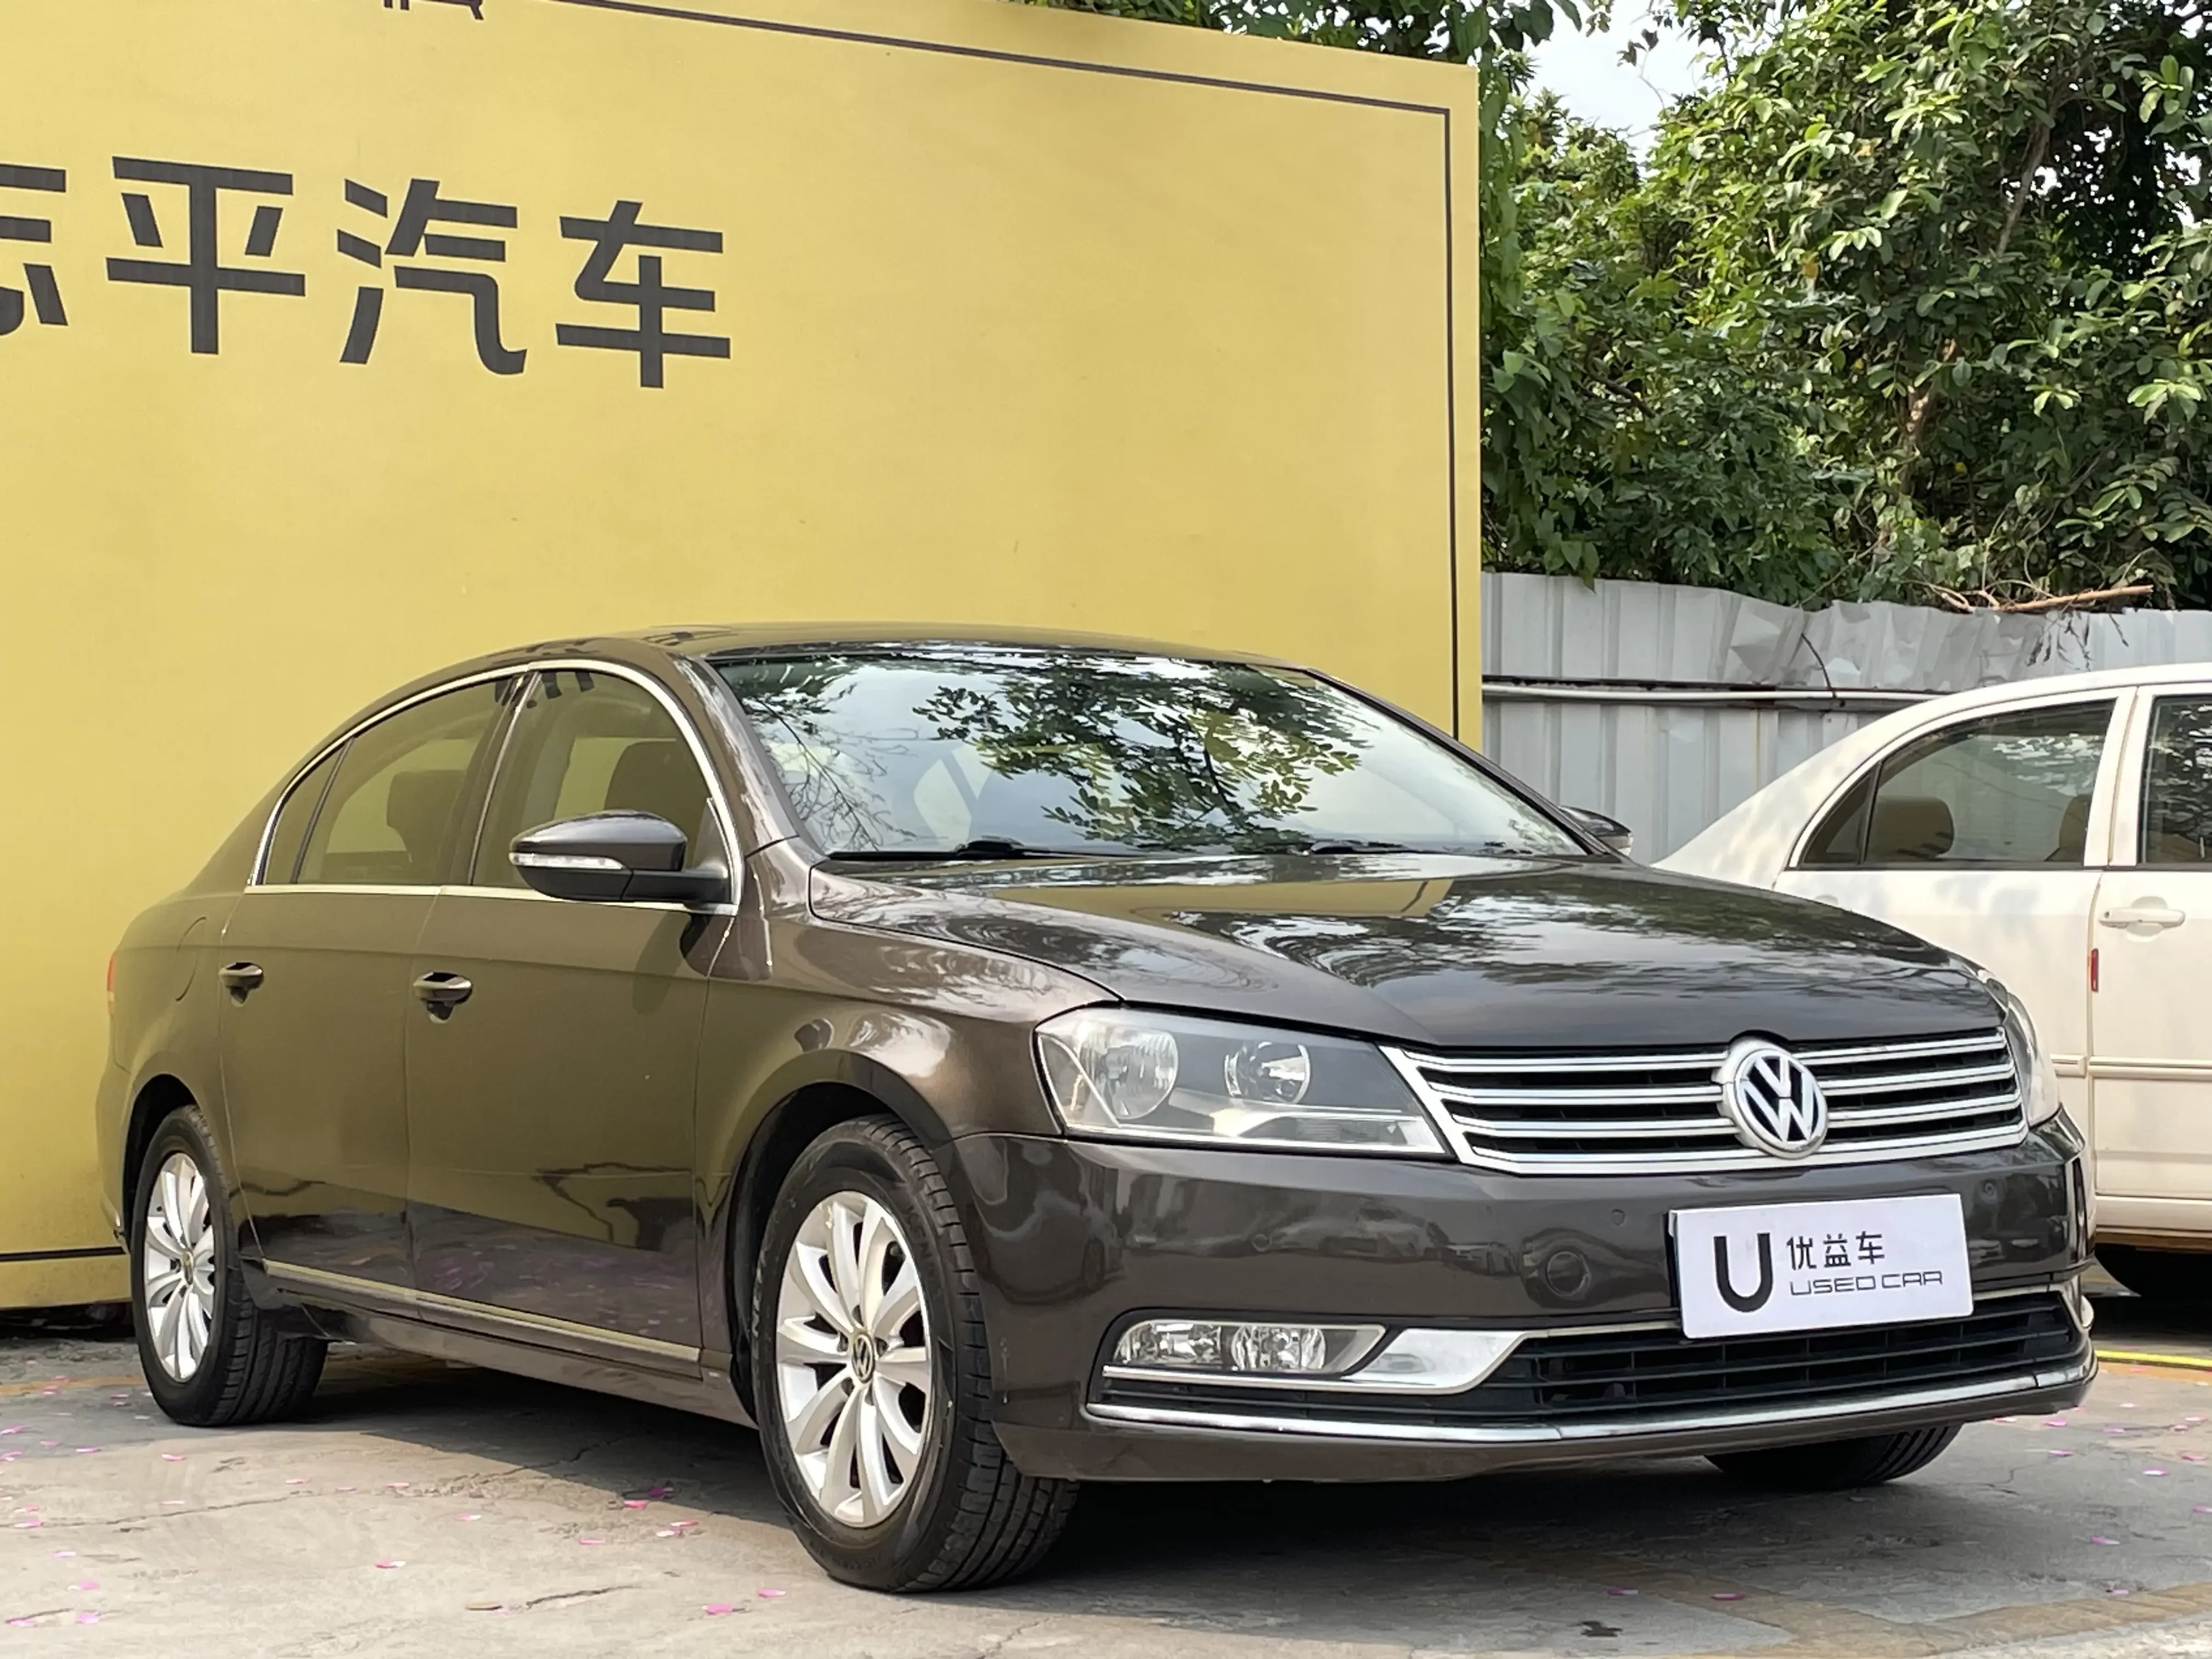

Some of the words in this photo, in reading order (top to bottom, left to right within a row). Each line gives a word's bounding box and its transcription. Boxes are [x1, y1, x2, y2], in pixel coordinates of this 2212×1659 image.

[1786, 1231, 1885, 1271] 优益车
[1790, 1276, 1876, 1296] USED
[1881, 1271, 1943, 1289] CAR
